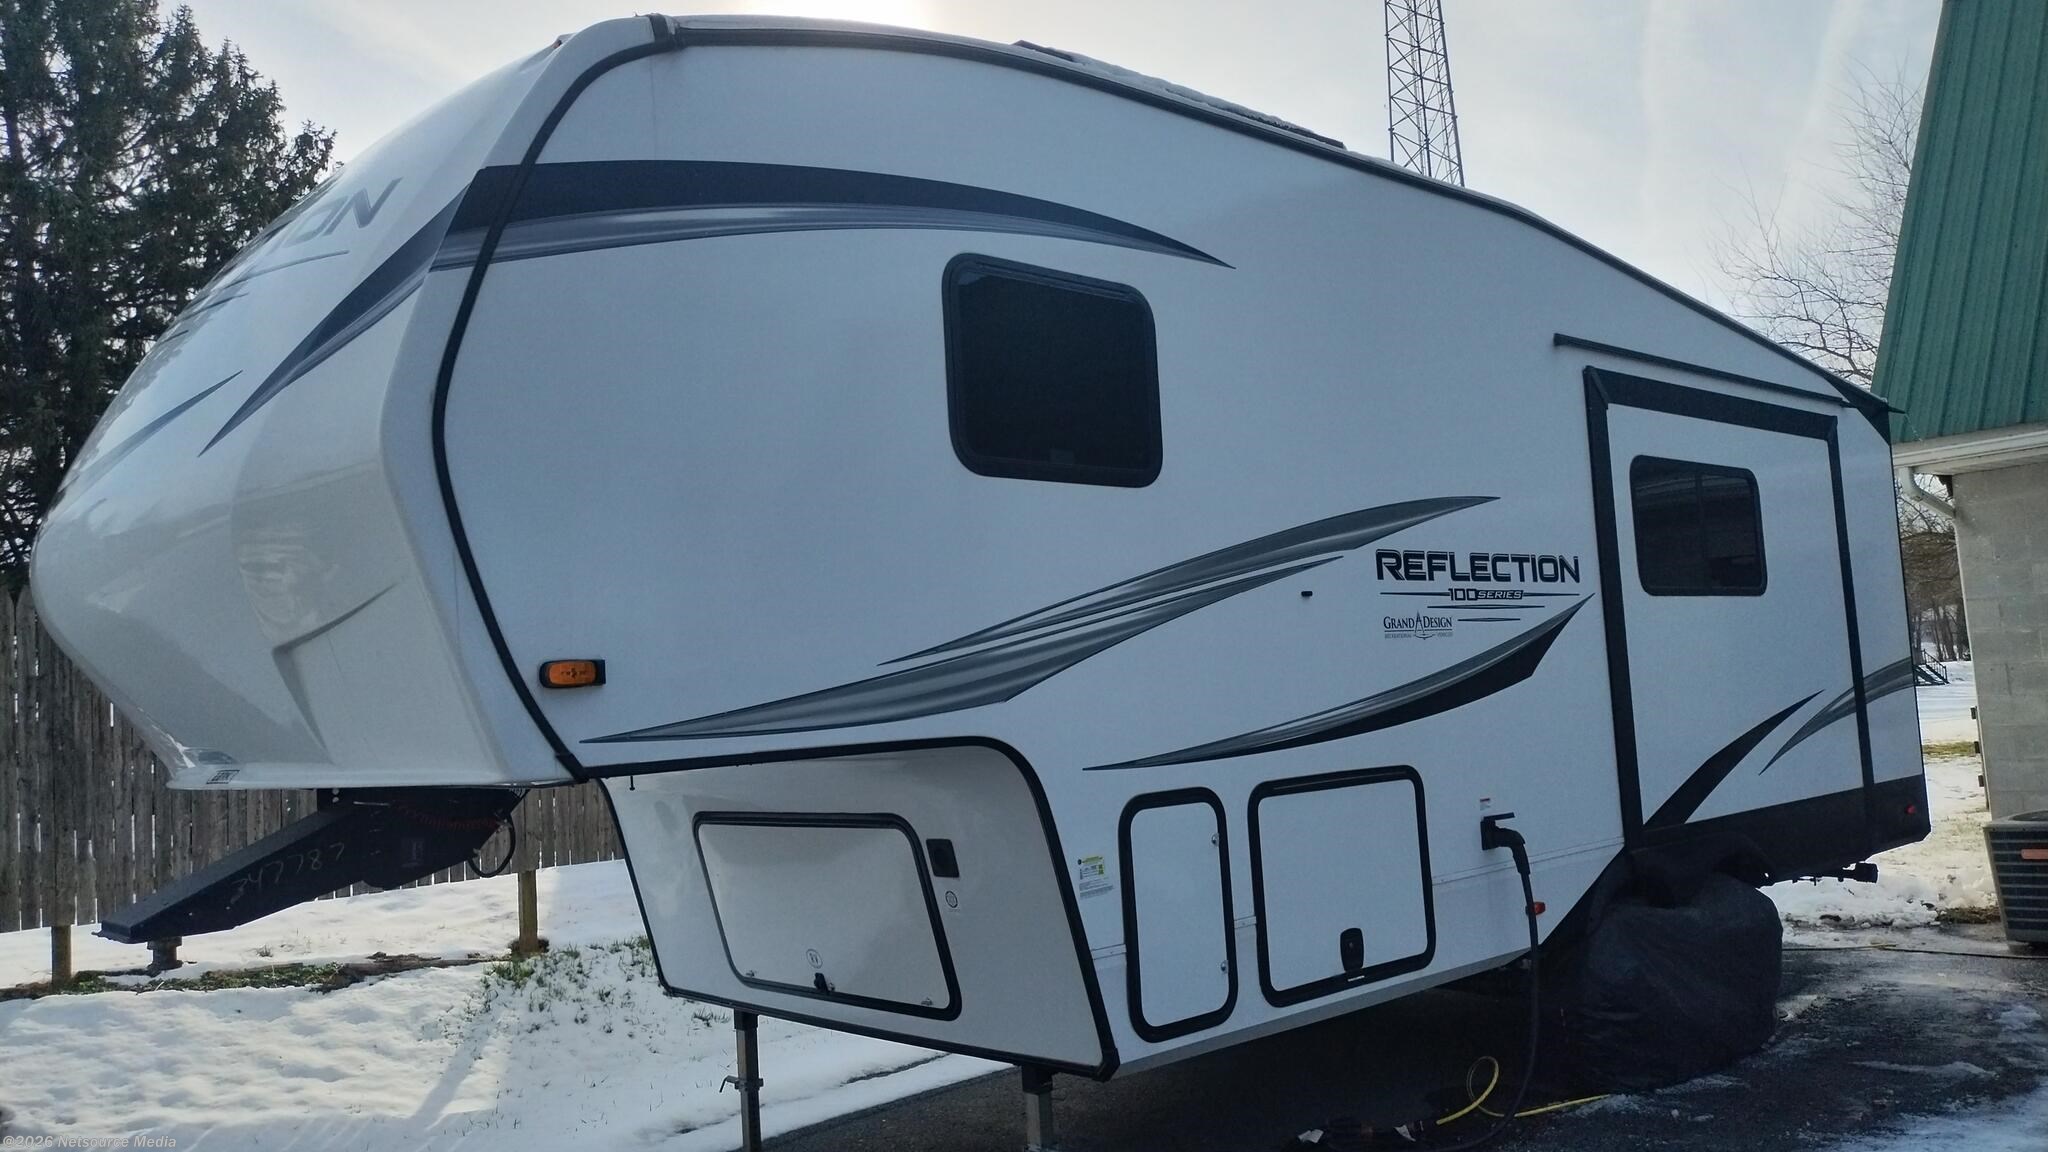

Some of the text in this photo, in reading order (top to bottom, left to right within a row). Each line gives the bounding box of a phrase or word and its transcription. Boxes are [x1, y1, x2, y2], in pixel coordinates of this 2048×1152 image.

[1376, 549, 1580, 583] REFLECTION
[1448, 588, 1523, 601] 100 SERIES
[1383, 616, 1453, 629] GRAND DESIGN
